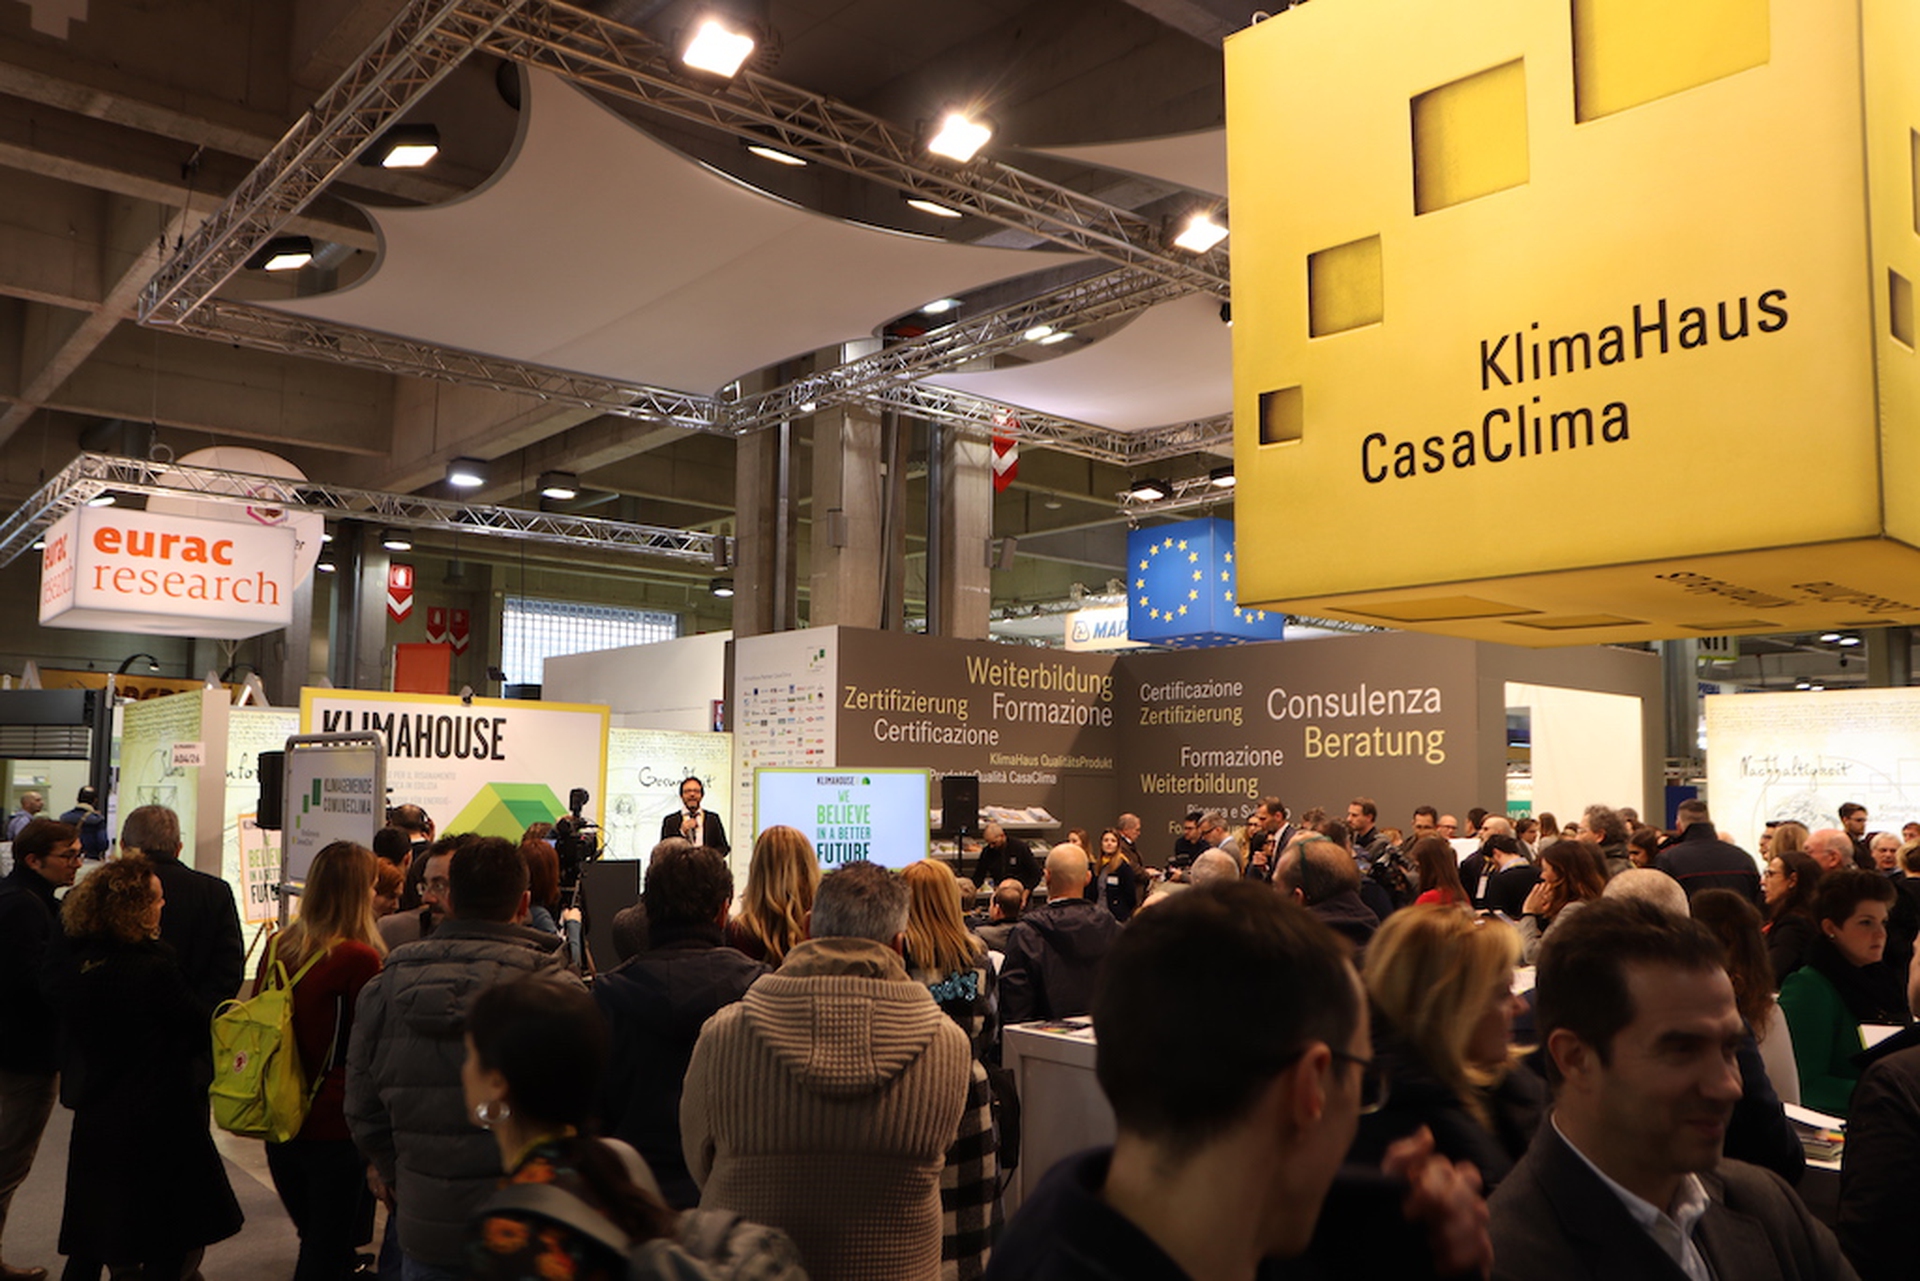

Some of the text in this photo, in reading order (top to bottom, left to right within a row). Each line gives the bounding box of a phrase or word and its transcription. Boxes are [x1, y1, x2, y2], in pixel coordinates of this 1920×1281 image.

[1480, 289, 1789, 391] KlimaHaus
[1362, 396, 1630, 484] CasaClima
[93, 527, 234, 565] eurac
[93, 564, 280, 606] research
[1092, 619, 1128, 639] MAP
[967, 655, 1113, 702] Weiterbildung
[1140, 679, 1243, 702] Certificazione
[844, 685, 969, 720] Zertifizierung
[993, 692, 1113, 727] Formazione
[1140, 704, 1243, 727] Zertifizierung
[1267, 683, 1442, 721] Consulenza
[323, 710, 507, 761] KLIMAHOUSE
[874, 718, 999, 747] Certificazione
[1305, 726, 1446, 765] Beratung
[990, 752, 1113, 769] KlimaHaus QualitätsProdukt
[1181, 746, 1283, 767] Formazione
[1009, 771, 1057, 784] CasaClima
[1141, 773, 1259, 799] Weiterbildung
[838, 790, 850, 803] WE
[816, 804, 871, 825] BELIEVE
[816, 826, 871, 840] IN A BETTER
[816, 842, 871, 863] FUTURE
